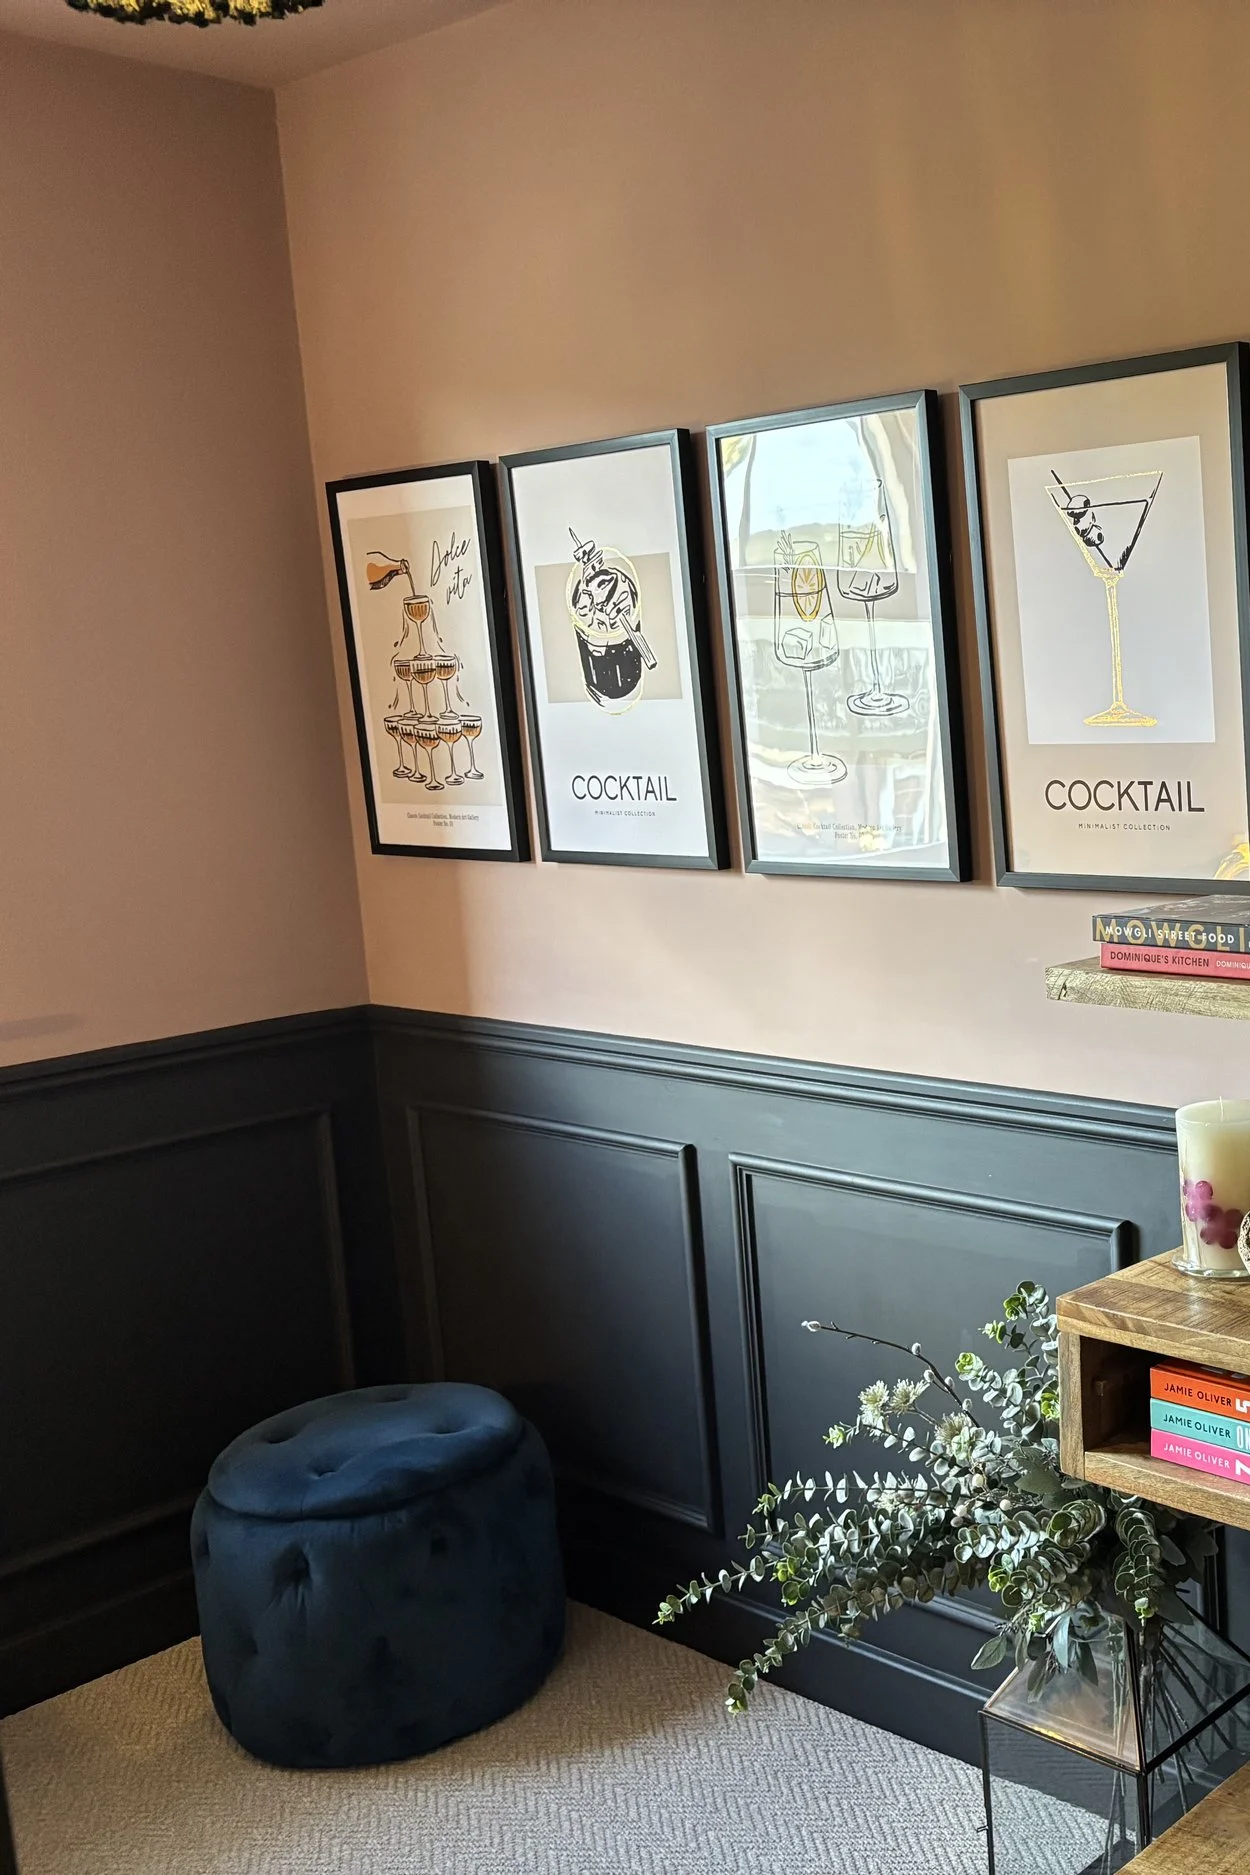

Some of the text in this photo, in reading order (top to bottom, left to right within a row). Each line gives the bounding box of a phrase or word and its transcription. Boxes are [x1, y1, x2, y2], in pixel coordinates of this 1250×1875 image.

[430, 531, 471, 588] Dolce
[446, 565, 472, 605] vita
[572, 774, 677, 802] COCKTAIL
[1044, 779, 1205, 813] COCKTAIL
[1078, 823, 1171, 832] MINIMALIST COLLECTION
[1105, 925, 1235, 944] MOWGLI STREET FOOD
[1110, 951, 1209, 967] DOMINIQUE'S KITCHEN
[1164, 1383, 1193, 1397] JAMIE
[1196, 1391, 1232, 1407] OLIVER
[1163, 1413, 1192, 1428] JAMIE
[1194, 1421, 1231, 1438] OLIVER
[1163, 1443, 1192, 1457] JAMIE
[1194, 1451, 1230, 1469] OLIVER
